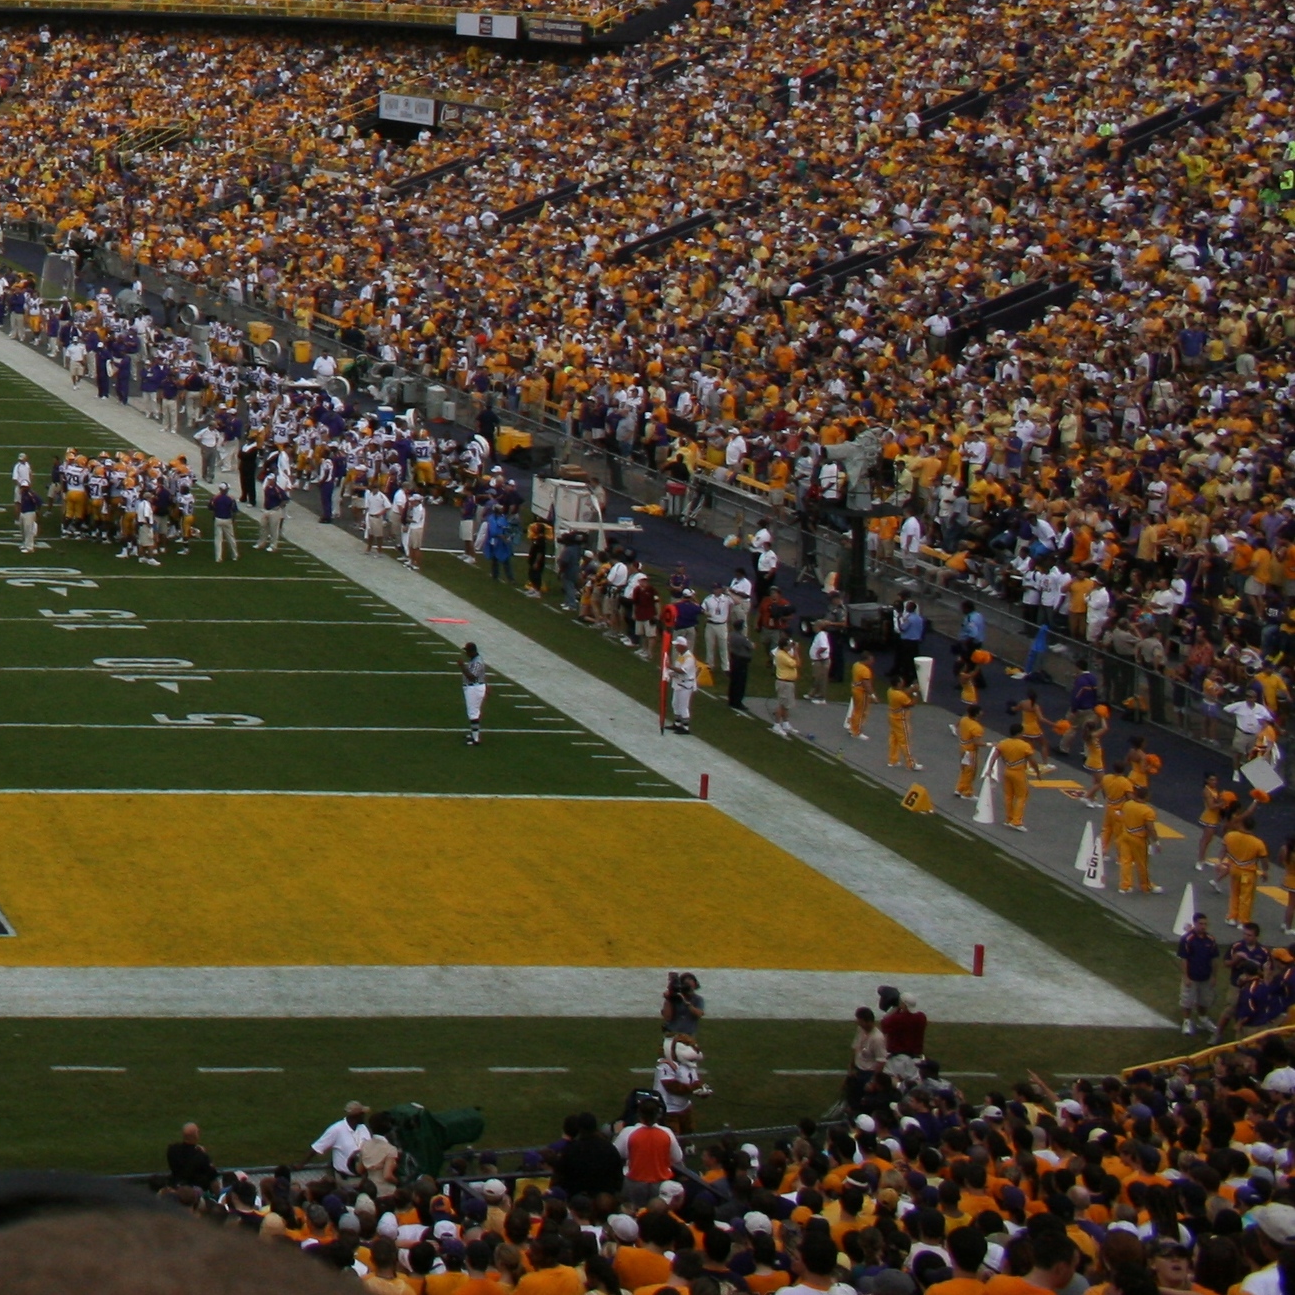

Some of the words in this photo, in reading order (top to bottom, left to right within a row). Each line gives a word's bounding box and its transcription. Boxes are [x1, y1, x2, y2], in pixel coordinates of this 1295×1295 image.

[67, 472, 80, 487] 79
[37, 609, 149, 631] 15
[92, 657, 213, 682] 10
[151, 713, 265, 726] 5
[905, 791, 919, 807] G
[1087, 845, 1099, 880] LSU
